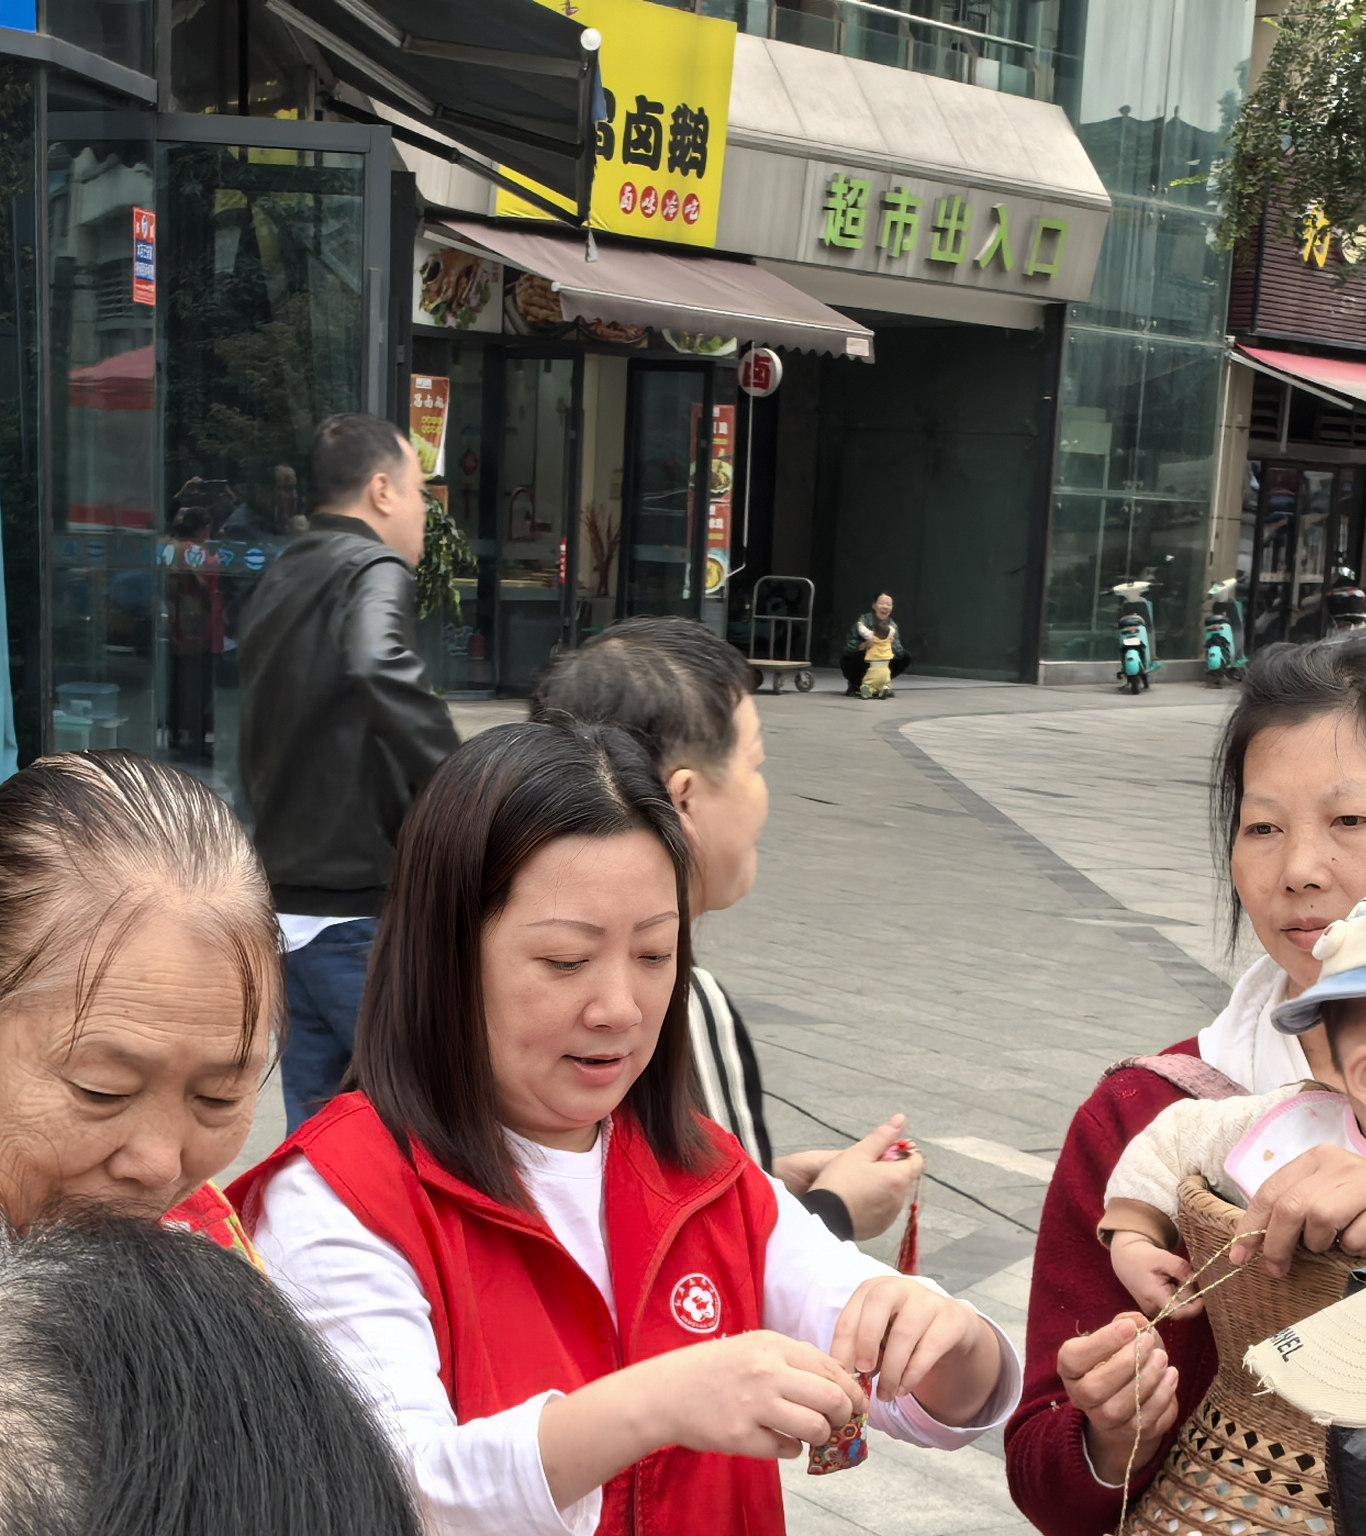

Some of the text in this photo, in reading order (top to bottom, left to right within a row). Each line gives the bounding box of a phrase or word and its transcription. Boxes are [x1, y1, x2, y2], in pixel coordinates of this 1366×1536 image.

[821, 173, 1069, 279] 超市出入口
